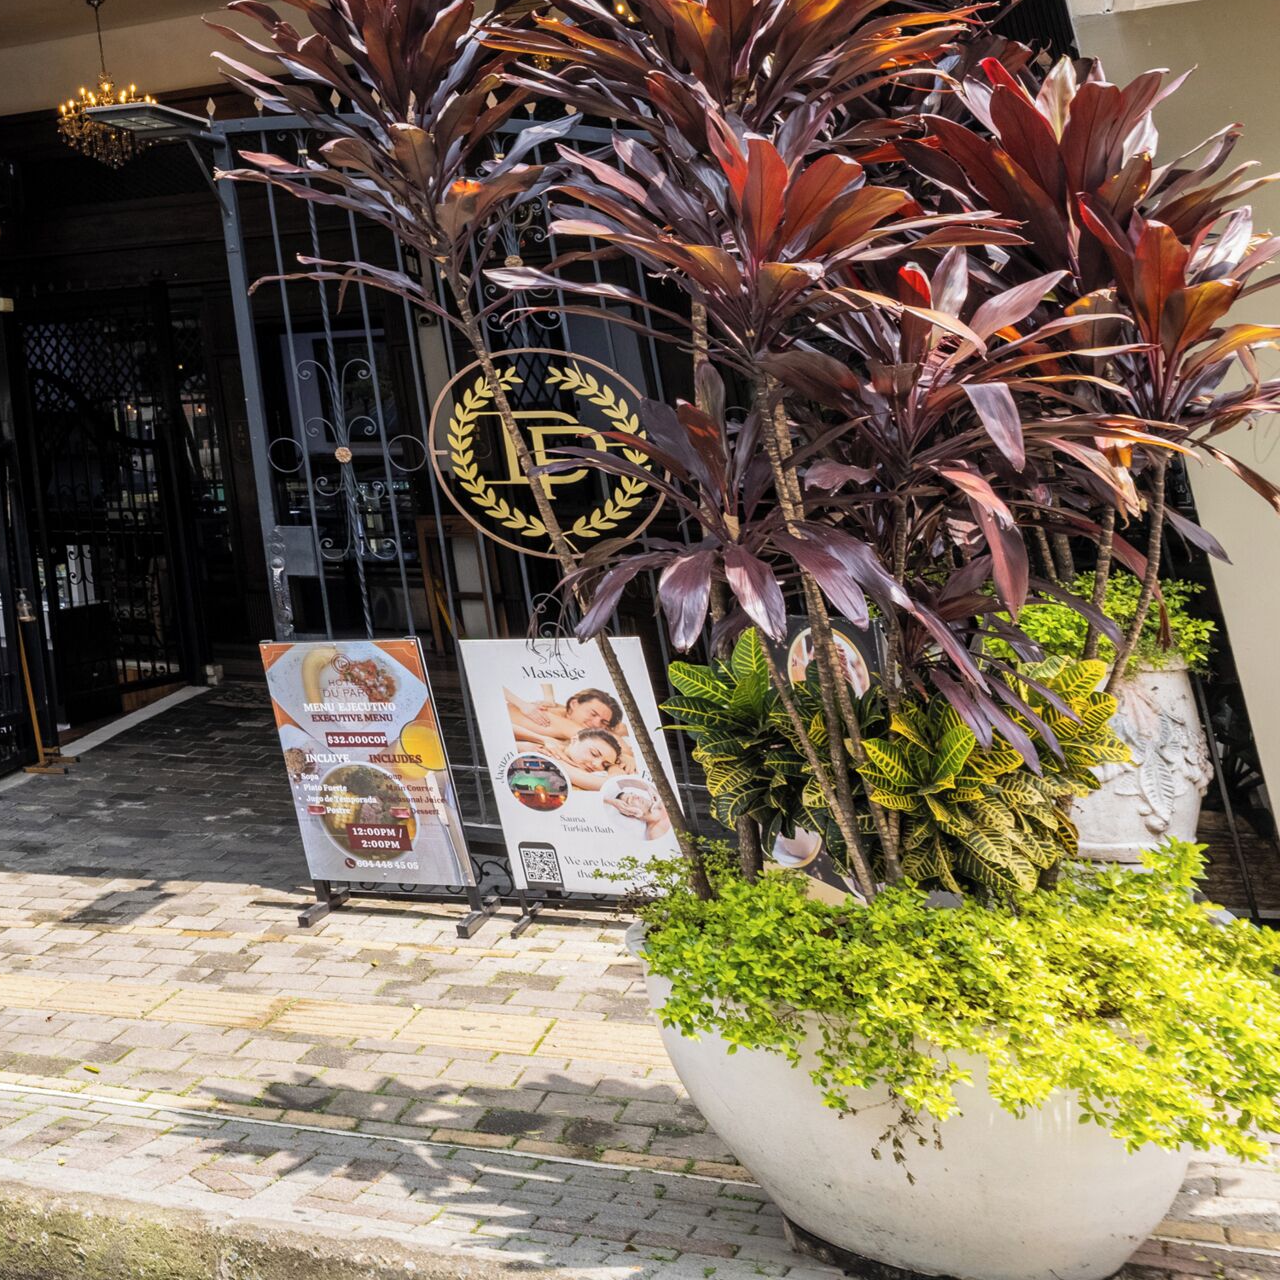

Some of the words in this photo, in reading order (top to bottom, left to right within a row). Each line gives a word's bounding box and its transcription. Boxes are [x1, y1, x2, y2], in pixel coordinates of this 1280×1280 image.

[522, 666, 586, 681] Massage
[323, 688, 339, 698] DU
[304, 702, 335, 712] MENU
[339, 702, 396, 712] EJECUTIVO
[312, 714, 363, 722] EXECUTIVE
[364, 714, 393, 722] MENU
[327, 736, 387, 745] $32.000COP
[305, 754, 351, 763] INCLUYE
[369, 754, 423, 763] INCLUDES
[301, 773, 319, 782] Sopa
[323, 784, 347, 792] Fuerte
[386, 784, 406, 792] Main
[306, 795, 324, 805] Jugo
[335, 796, 377, 804] Temporada
[559, 815, 586, 823] Sauna
[352, 827, 396, 836] 12:00PM
[562, 824, 593, 833] Turkish
[594, 826, 615, 834] Bath
[361, 840, 401, 849] 2:00PM
[564, 856, 581, 866] We
